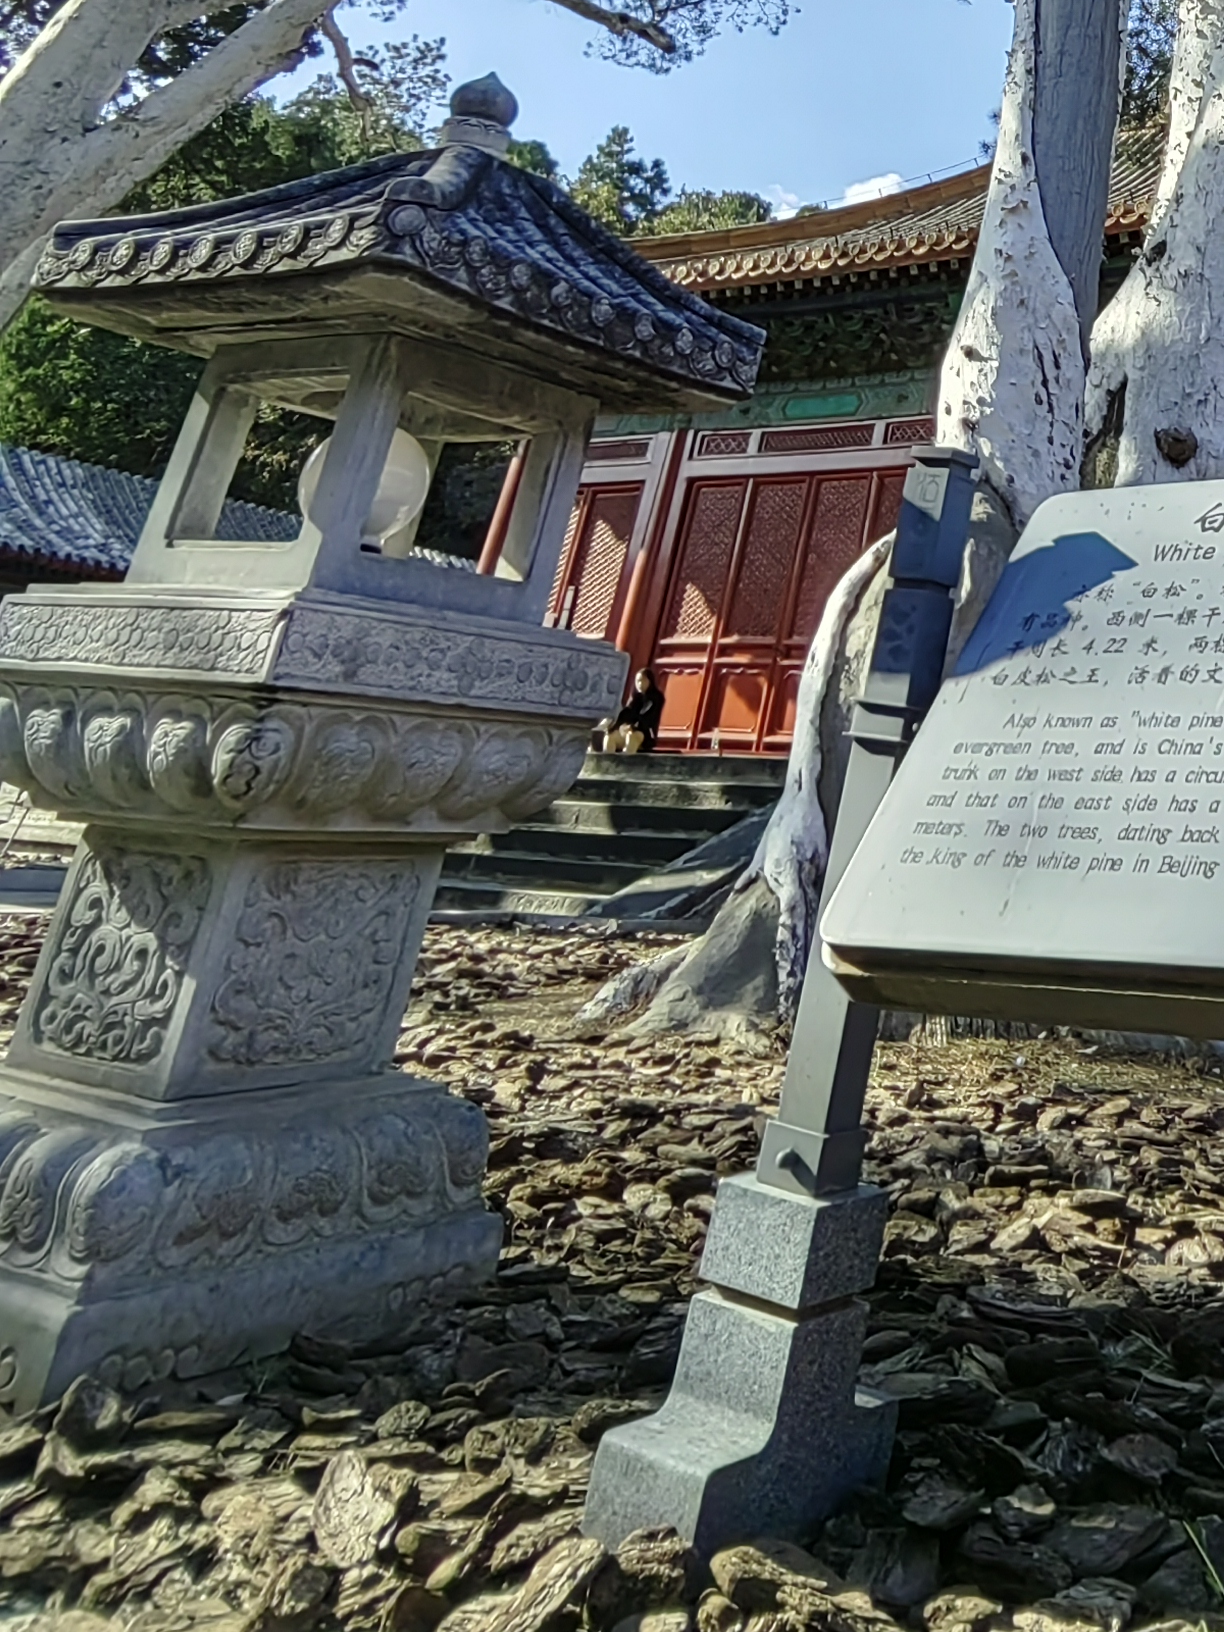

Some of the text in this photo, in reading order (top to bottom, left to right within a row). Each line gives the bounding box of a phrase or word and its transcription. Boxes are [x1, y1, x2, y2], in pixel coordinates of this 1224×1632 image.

[1154, 542, 1216, 562] White
[1082, 637, 1127, 656] 4.22
[1003, 713, 1036, 729] Also
[1043, 713, 1092, 729] known
[1100, 716, 1118, 728] as
[953, 741, 1032, 757] evergreen
[1041, 740, 1079, 757] tree,
[1094, 738, 1125, 755] and
[1133, 738, 1147, 755] is
[1157, 736, 1223, 756] China's
[942, 764, 978, 781] trunk
[988, 768, 1006, 781] on
[1015, 764, 1038, 781] the
[1047, 767, 1084, 782] west
[1091, 765, 1122, 782] side
[1130, 766, 1157, 783] has
[1165, 770, 1177, 783] a
[926, 791, 958, 807] and
[965, 793, 999, 808] that
[1008, 795, 1027, 808] on
[1038, 793, 1064, 810] the
[1074, 795, 1113, 810] east
[1122, 793, 1157, 812] side
[1167, 794, 1198, 813] has
[1209, 800, 1221, 813] a
[913, 819, 967, 838] meters.
[984, 819, 1010, 837] The
[1020, 823, 1048, 838] two
[1058, 824, 1102, 844] trees,
[1117, 823, 1172, 845] dating
[1180, 824, 1220, 844] back
[900, 846, 923, 864] the
[930, 847, 967, 869] king
[974, 849, 996, 866] of
[1003, 850, 1026, 868] the
[1037, 851, 1080, 870] white
[1086, 852, 1123, 875] pine
[1132, 853, 1150, 873] in
[1157, 855, 1220, 879] Beijing
